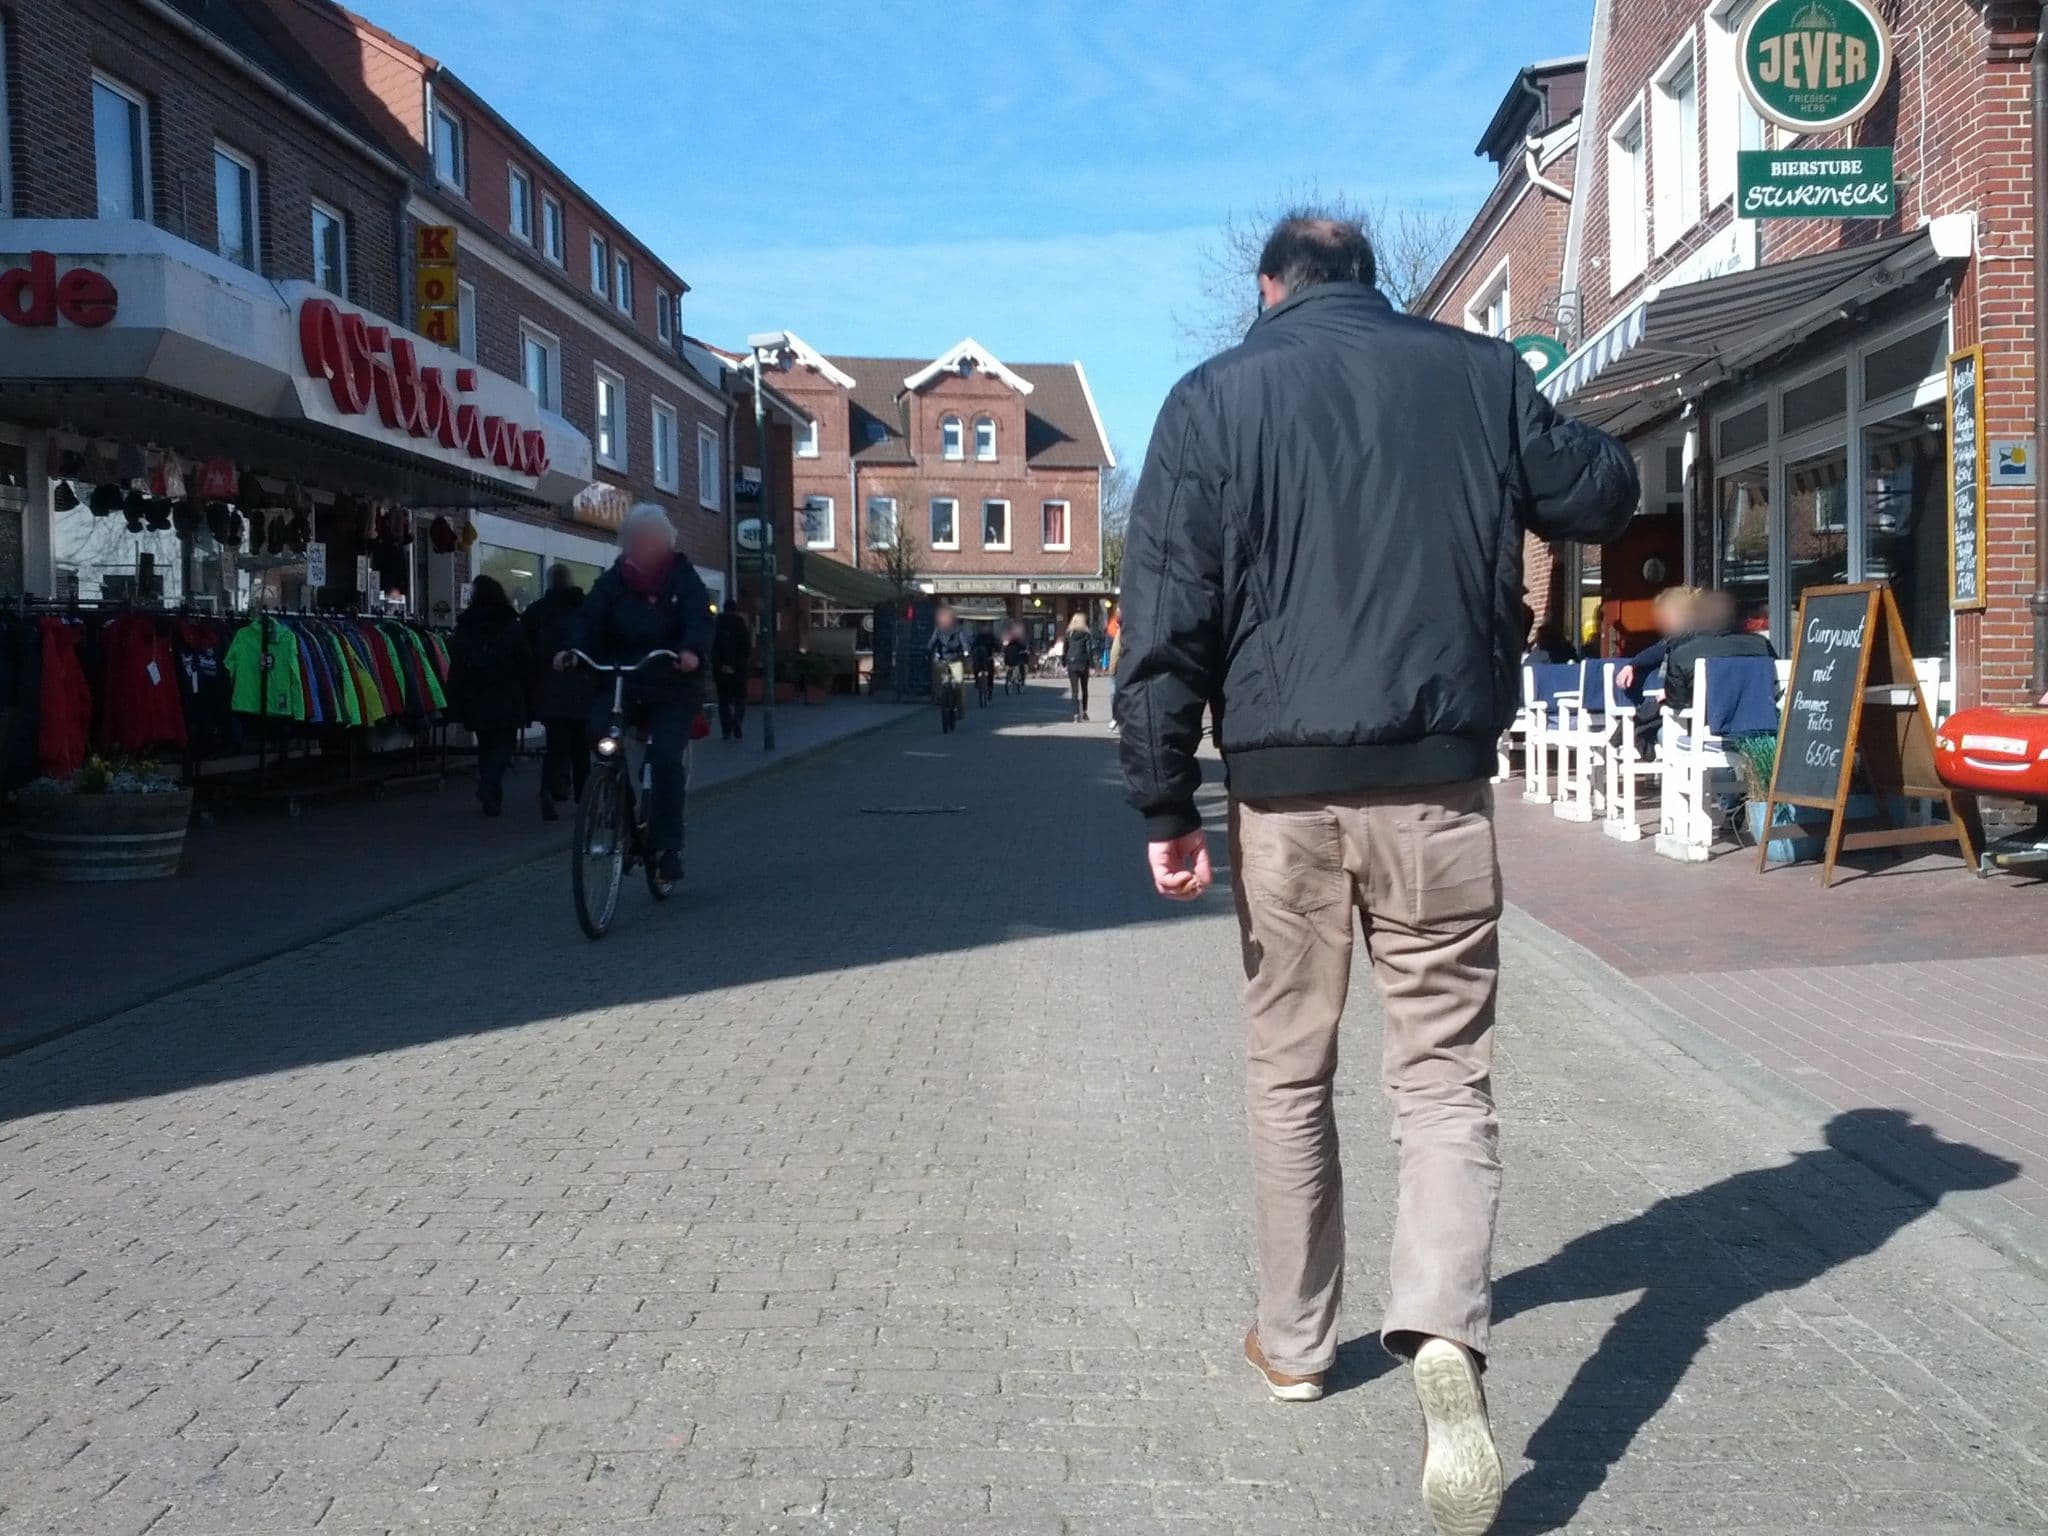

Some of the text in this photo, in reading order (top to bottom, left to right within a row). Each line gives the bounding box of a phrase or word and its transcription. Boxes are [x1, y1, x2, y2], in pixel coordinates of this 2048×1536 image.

[1759, 32, 1867, 89] JEVER
[1789, 94, 1838, 105] FRIESISCH
[1800, 104, 1826, 113] HERB
[1771, 160, 1863, 176] BIERSTUBE
[300, 298, 549, 477] Vitrine
[1807, 615, 1865, 654] Currywurst
[1812, 659, 1836, 682] mit
[1793, 690, 1829, 712] Pommes
